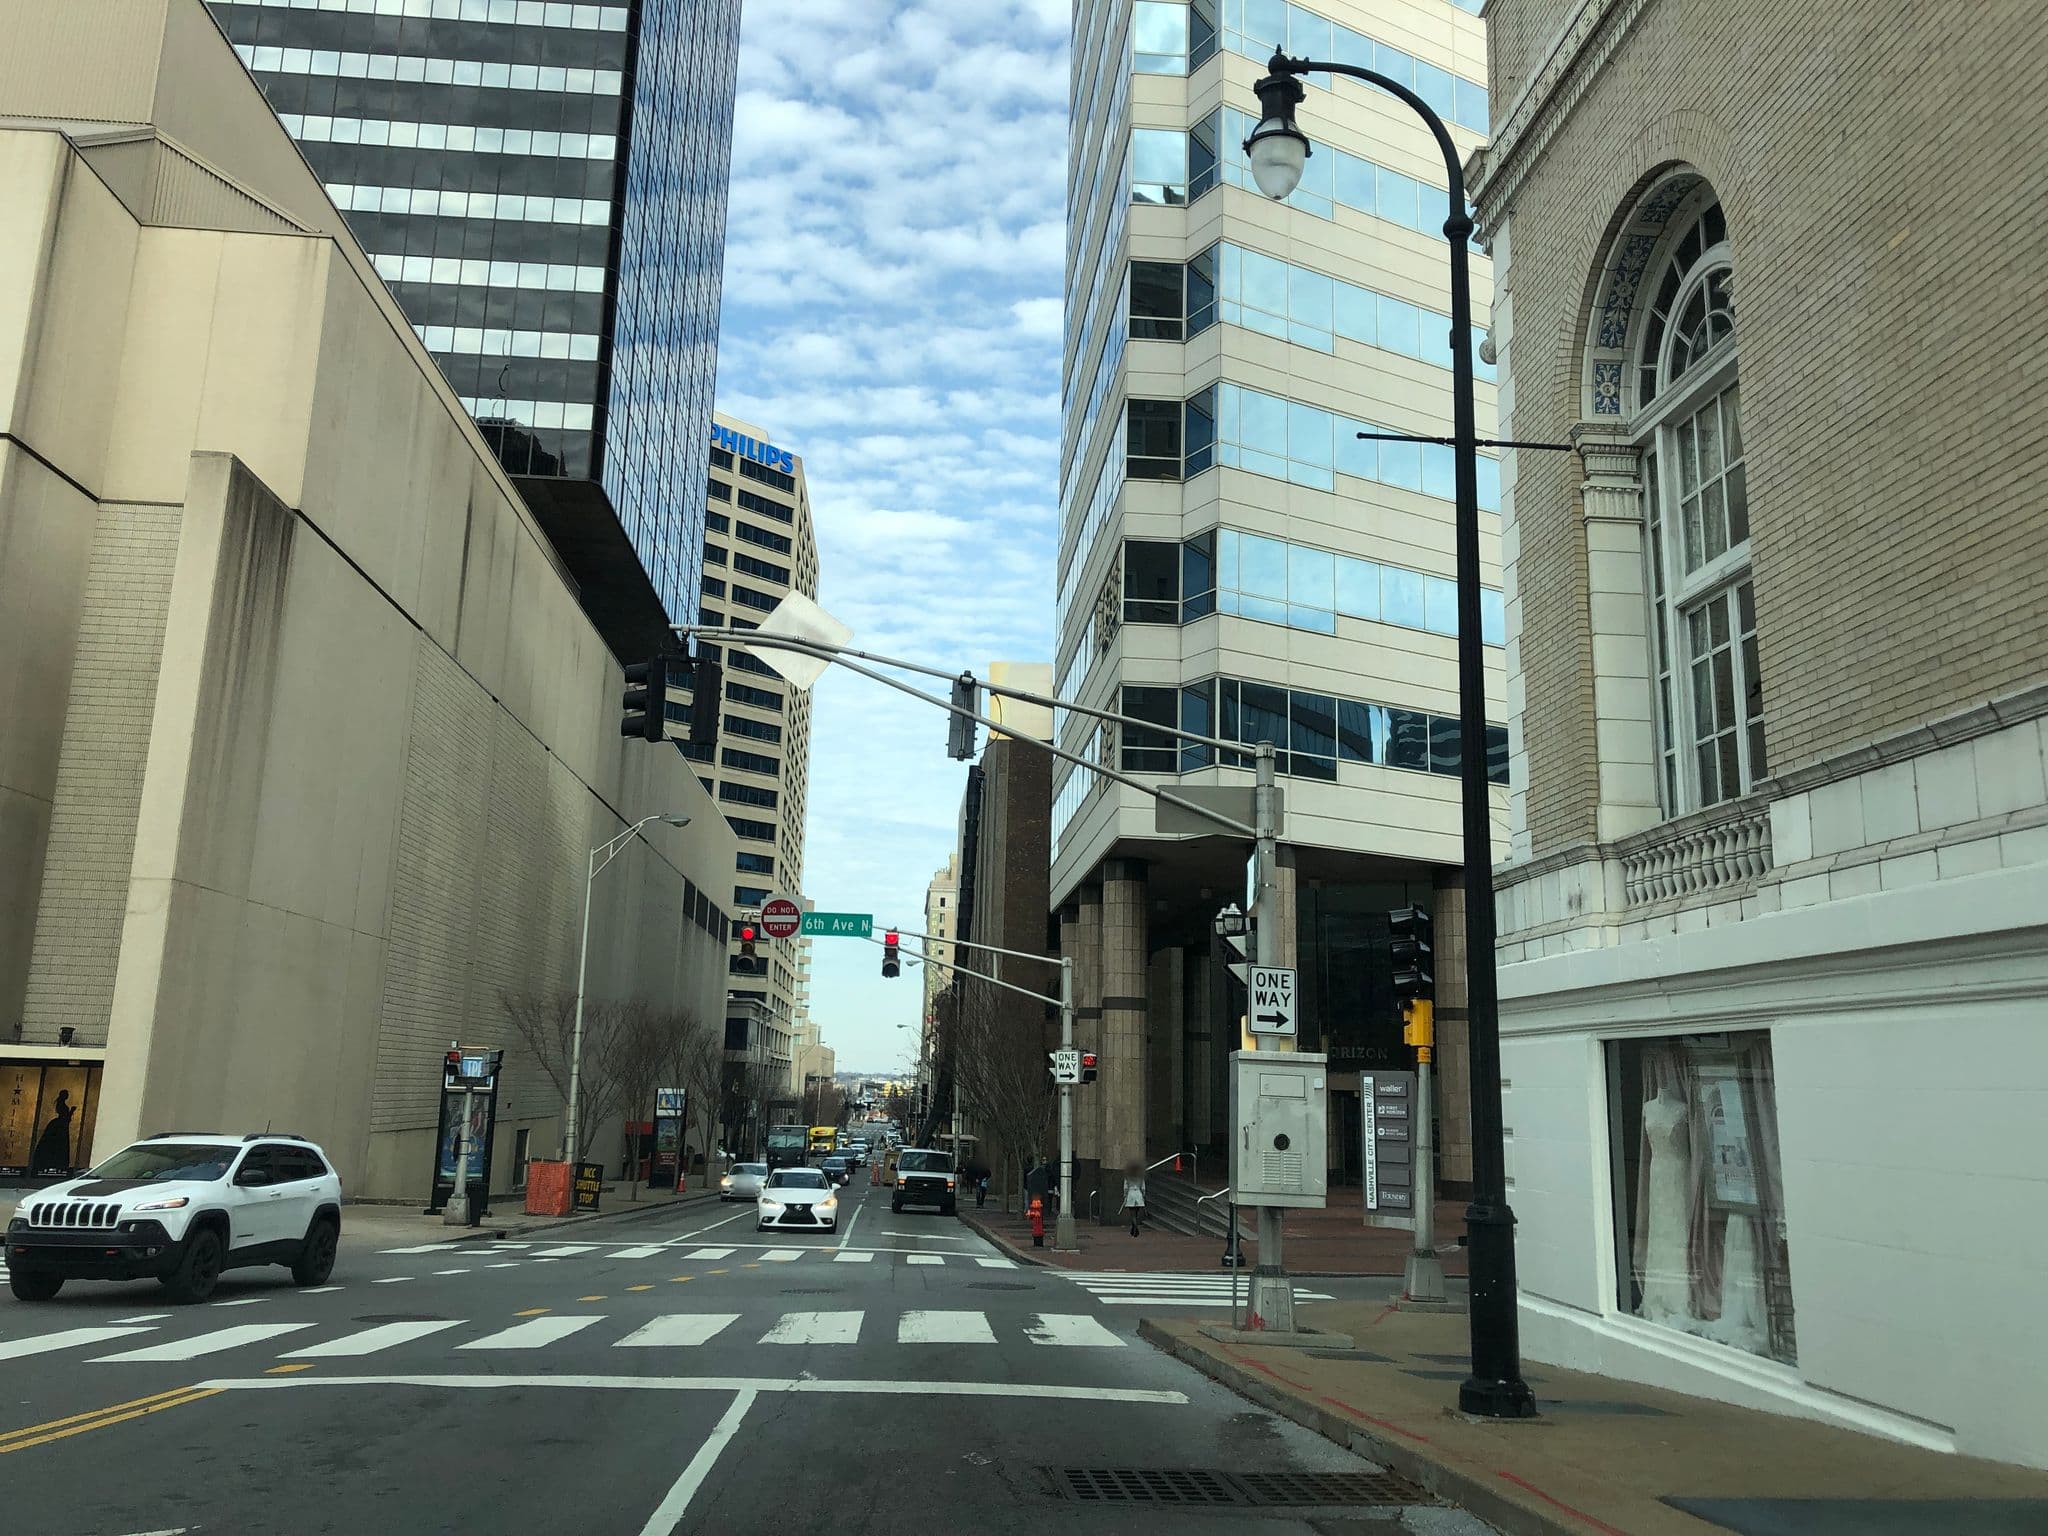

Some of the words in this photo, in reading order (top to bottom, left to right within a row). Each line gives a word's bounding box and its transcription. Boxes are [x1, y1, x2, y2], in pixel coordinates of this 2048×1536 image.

[711, 422, 794, 474] PHILIPS
[769, 923, 792, 931] ENTER
[805, 918, 825, 930] 6th
[832, 918, 854, 931] Ave
[861, 919, 869, 932] N
[1256, 972, 1291, 989] ONE
[1255, 990, 1292, 1007] WAY
[1058, 1053, 1077, 1061] ONE
[1058, 1062, 1077, 1070] WAY
[1380, 1084, 1403, 1093] waller
[575, 1179, 601, 1192] SHUTTLE
[1367, 1160, 1375, 1203] NASHVILLE
[579, 1193, 594, 1204] STOP
